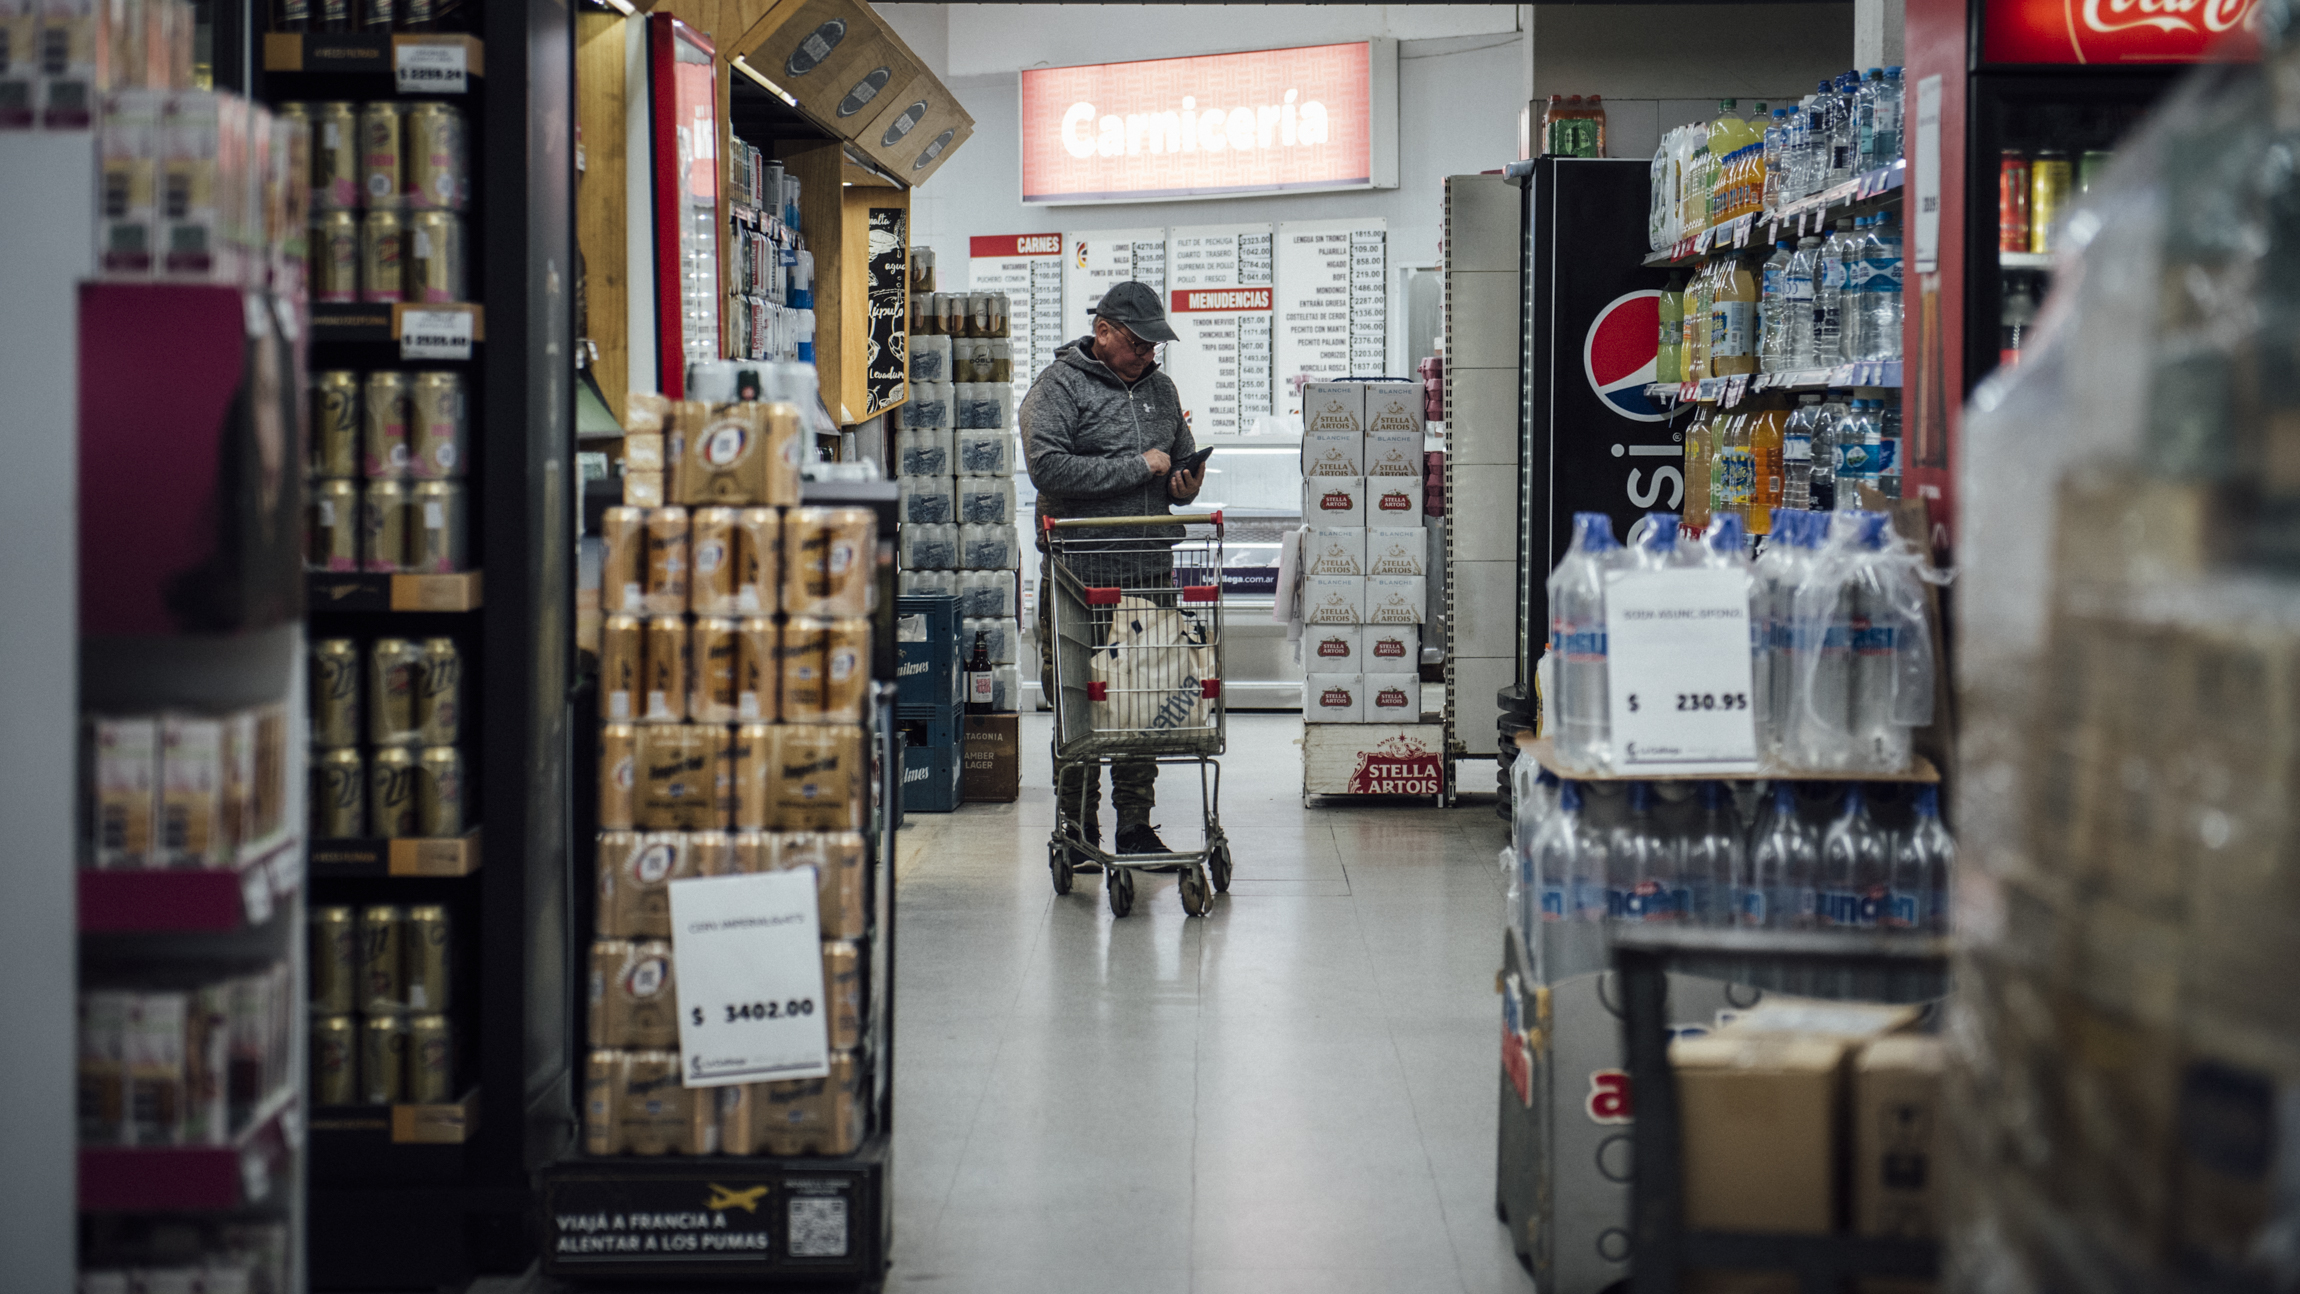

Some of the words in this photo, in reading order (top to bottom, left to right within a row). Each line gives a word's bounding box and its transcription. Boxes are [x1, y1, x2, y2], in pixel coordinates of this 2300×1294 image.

[1061, 88, 1329, 159] Carnicería
[1017, 236, 1060, 253] CARNES
[1243, 236, 1270, 244] 2323.00
[1207, 262, 1215, 270] DE
[1243, 261, 1270, 269] 2784.00
[1189, 291, 1269, 309] MENUDENCIAS
[1298, 338, 1320, 346] PECHITO
[1629, 694, 1639, 712] $
[1677, 693, 1747, 711] 230.95
[964, 732, 1003, 742] TAGONIA
[1377, 736, 1395, 748] ANNO
[964, 752, 994, 760] AMBER
[965, 761, 993, 769] LAGER
[1369, 764, 1438, 777] STELLA
[1368, 780, 1438, 793] ARTOIS
[692, 1007, 703, 1026] $
[725, 999, 813, 1023] 3402.00
[556, 1211, 608, 1233] VIAJÁ
[612, 1214, 626, 1230] A
[630, 1213, 709, 1230] FRANCIA
[713, 1212, 727, 1228] A
[558, 1235, 640, 1251] ALENTAR
[645, 1235, 658, 1250] A
[662, 1234, 698, 1250] LOS
[701, 1232, 768, 1249] PUMAS
